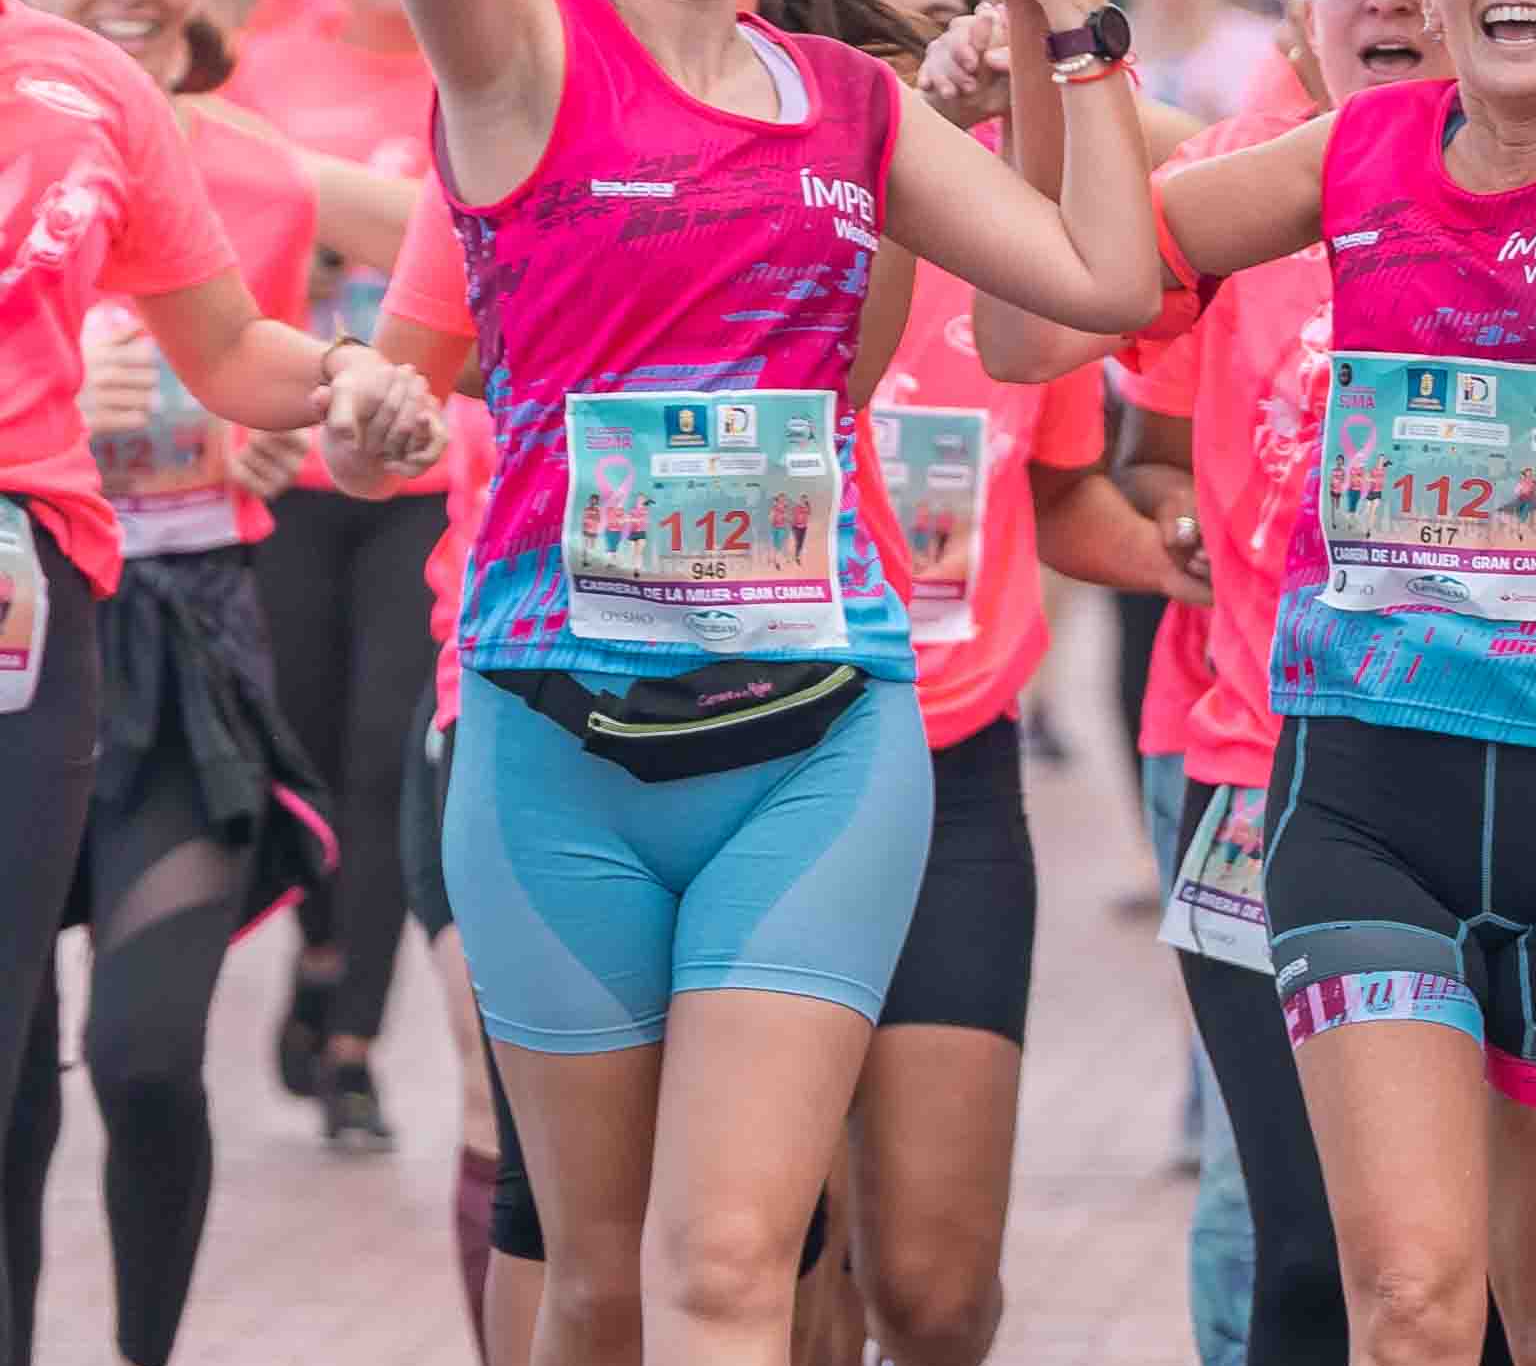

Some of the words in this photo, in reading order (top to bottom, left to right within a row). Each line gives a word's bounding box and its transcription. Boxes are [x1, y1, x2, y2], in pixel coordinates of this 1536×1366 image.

[1393, 473, 1494, 520] 112
[660, 509, 751, 552] 112
[1420, 526, 1460, 544] 617
[692, 562, 727, 579] 946
[1370, 548, 1388, 563] DE
[1391, 551, 1408, 565] LA
[1412, 552, 1460, 568] MUJER
[1472, 555, 1510, 571] GRAN
